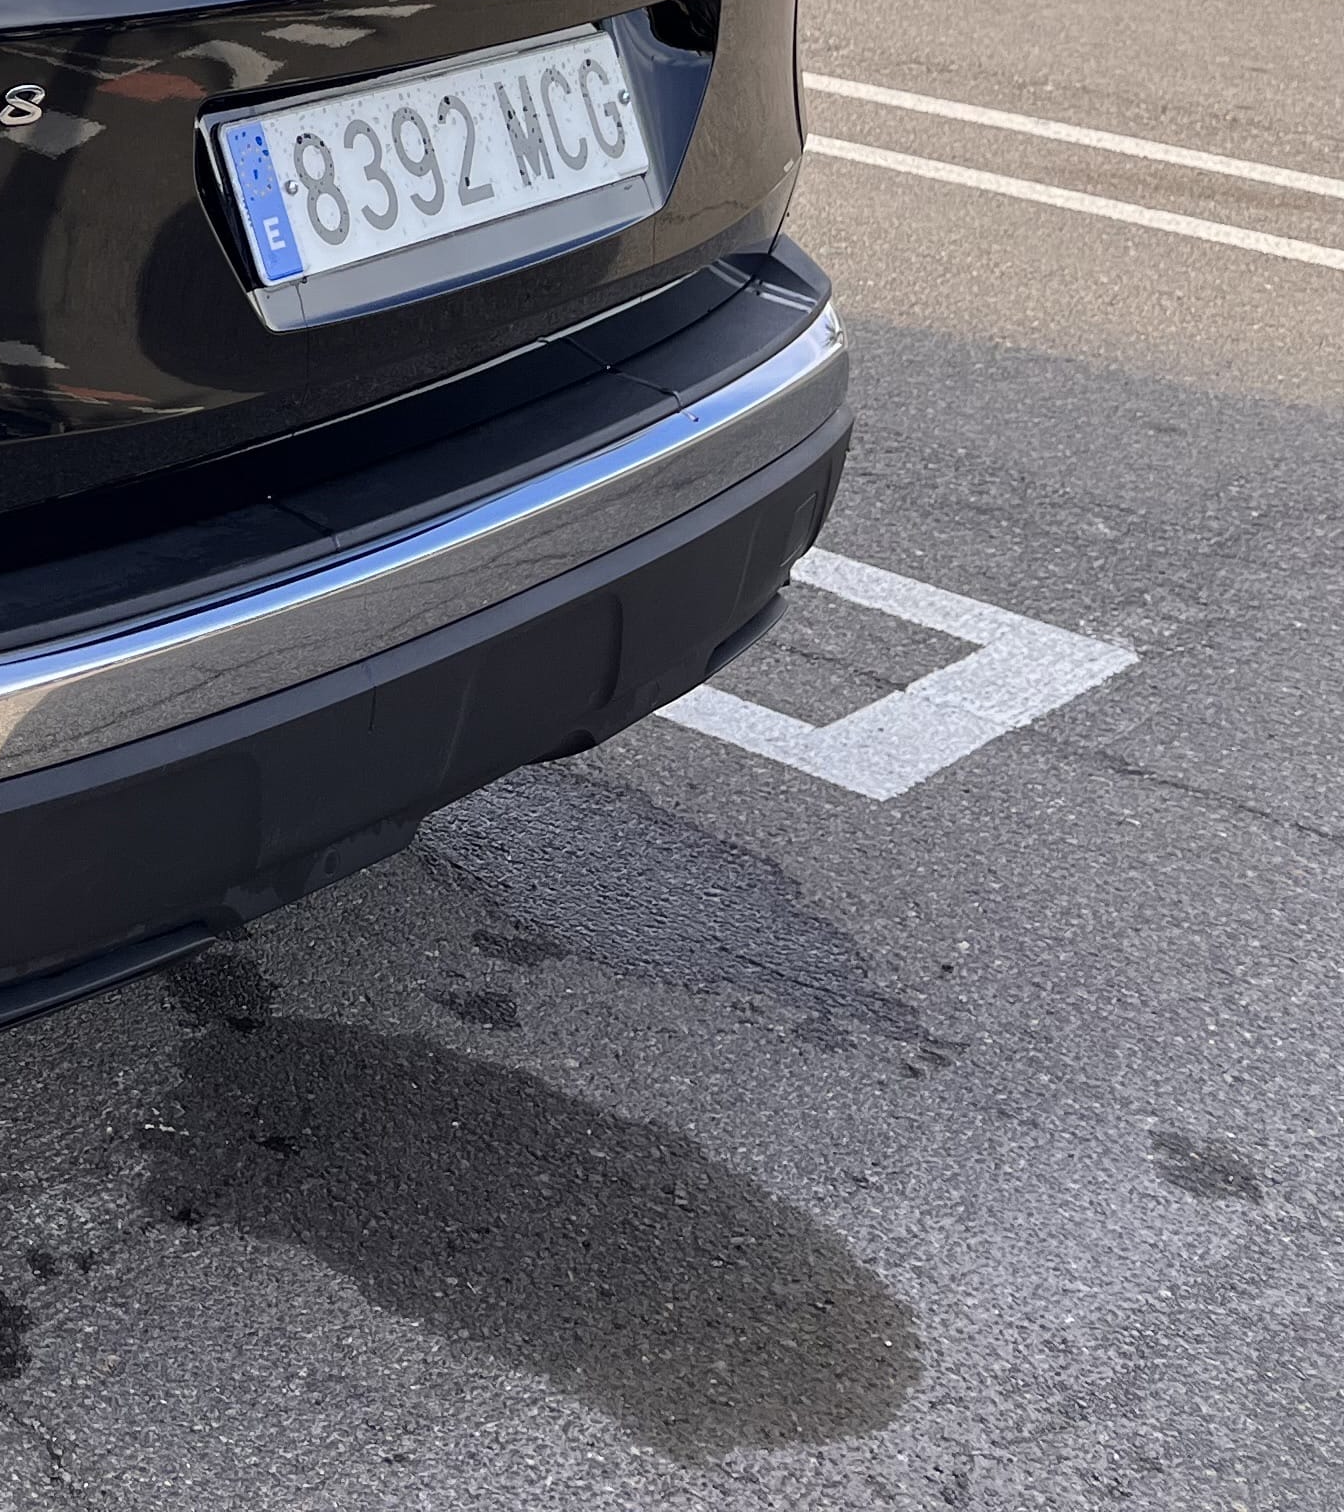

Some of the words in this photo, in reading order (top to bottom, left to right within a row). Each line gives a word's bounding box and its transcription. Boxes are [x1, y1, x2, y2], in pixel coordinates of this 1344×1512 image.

[292, 94, 495, 246] 8392
[494, 58, 627, 188] MCG
[262, 216, 287, 252] E
